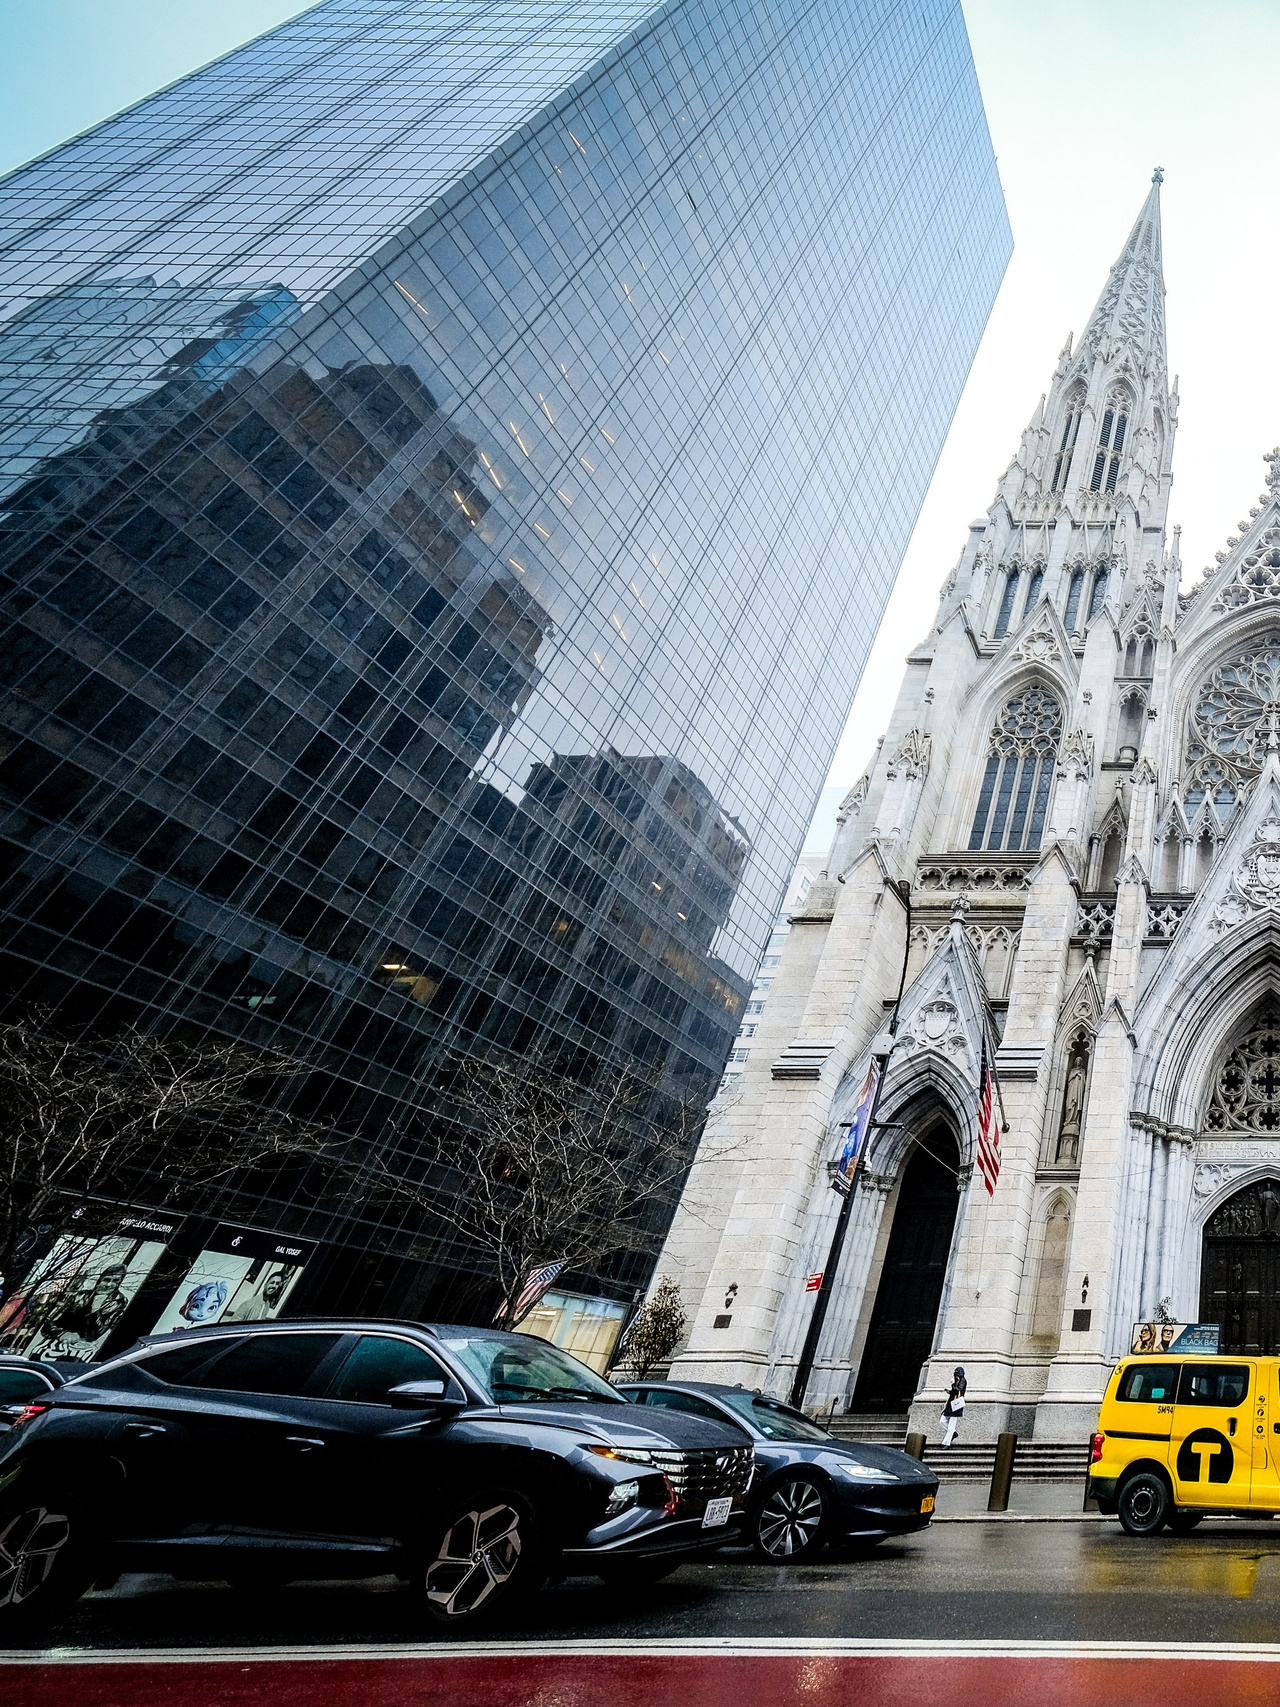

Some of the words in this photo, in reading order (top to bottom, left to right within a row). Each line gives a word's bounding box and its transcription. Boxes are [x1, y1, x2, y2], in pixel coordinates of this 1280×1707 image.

[145, 1222, 173, 1233] ACCARDI
[275, 1245, 285, 1254] GAL
[1180, 1338, 1203, 1346] BLACK
[1204, 1339, 1218, 1347] BAG
